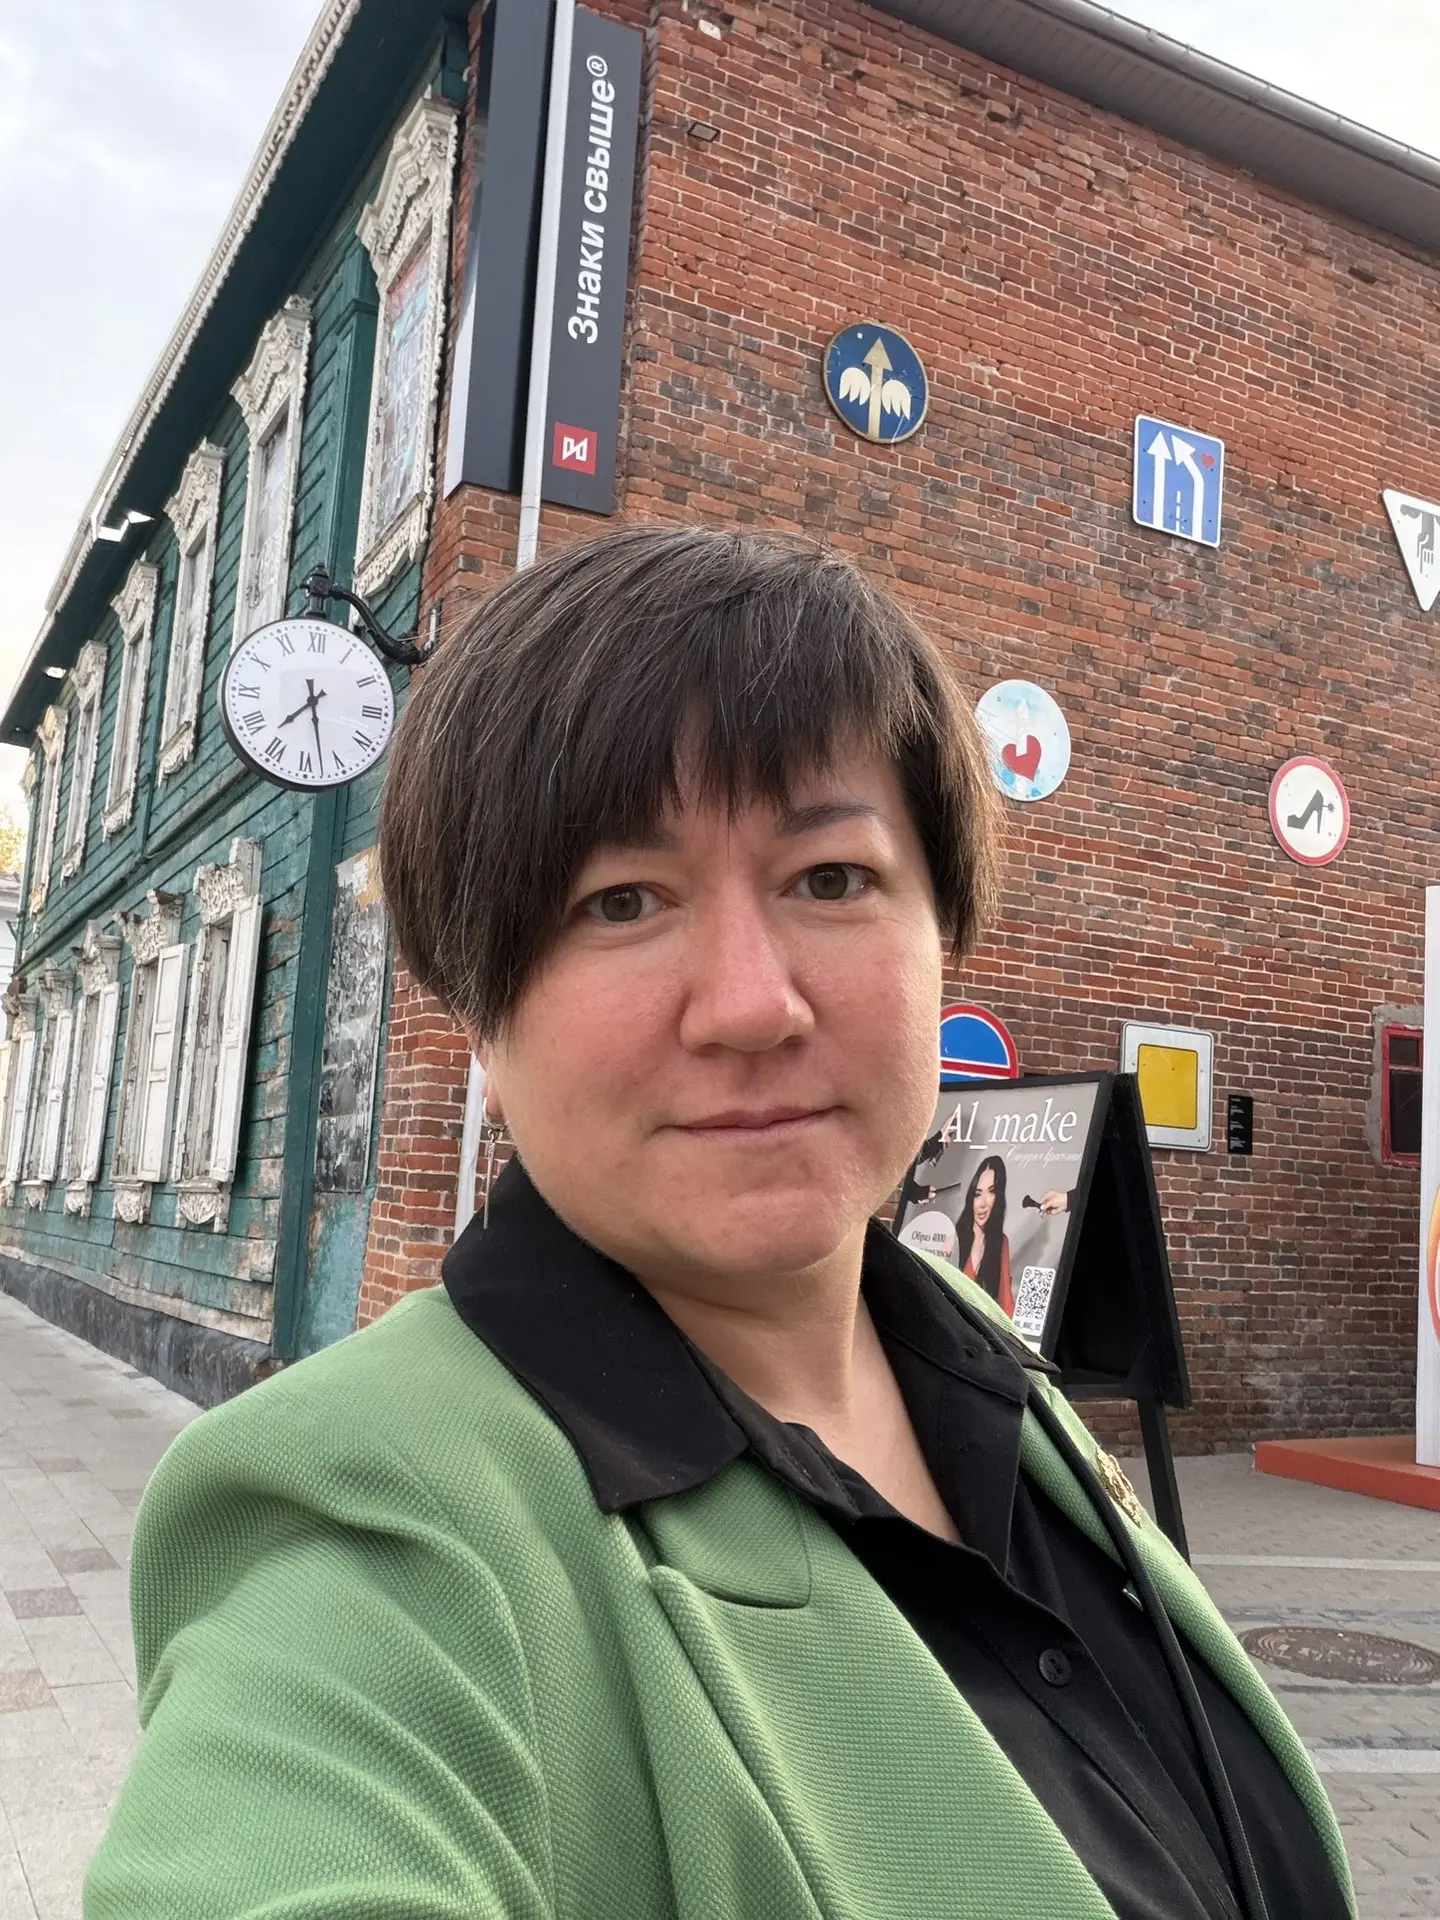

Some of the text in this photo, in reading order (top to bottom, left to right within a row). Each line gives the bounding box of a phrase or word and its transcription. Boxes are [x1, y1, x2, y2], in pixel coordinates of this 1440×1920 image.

[568, 219, 605, 344] Знаки
[276, 634, 296, 657] XI
[307, 631, 326, 654] XII
[250, 652, 271, 672] X
[238, 683, 261, 699] IX
[356, 675, 377, 688] II
[242, 710, 267, 736] VIII
[362, 705, 382, 720] III
[264, 736, 287, 763] VII
[352, 730, 373, 752] IV
[299, 751, 312, 773] VI
[332, 750, 345, 770] V
